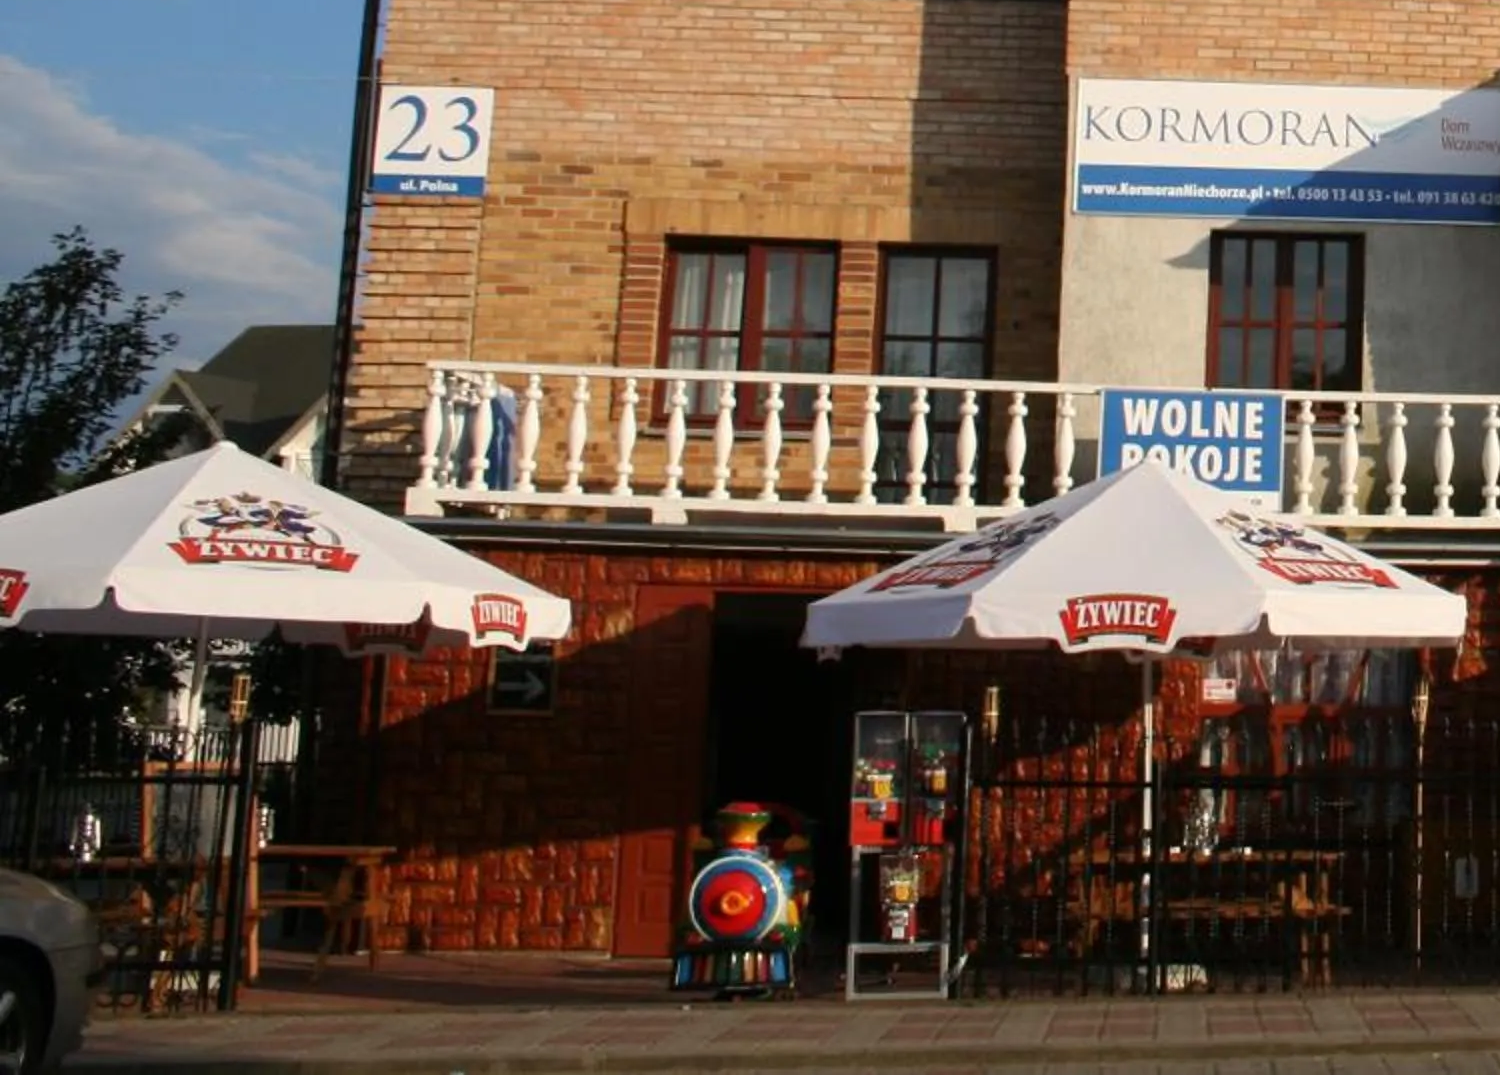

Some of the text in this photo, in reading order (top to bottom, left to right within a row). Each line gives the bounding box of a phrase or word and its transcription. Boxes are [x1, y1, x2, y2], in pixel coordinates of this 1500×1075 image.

[384, 95, 480, 161] 23
[1085, 104, 1377, 149] KORMORAN
[1441, 117, 1471, 134] Dom
[400, 180, 459, 192] ul. Polna
[1272, 186, 1295, 200] tel.
[1298, 187, 1329, 201] 0500
[1122, 398, 1265, 440] WOLNE
[1075, 599, 1161, 629] ŻYWIEC
